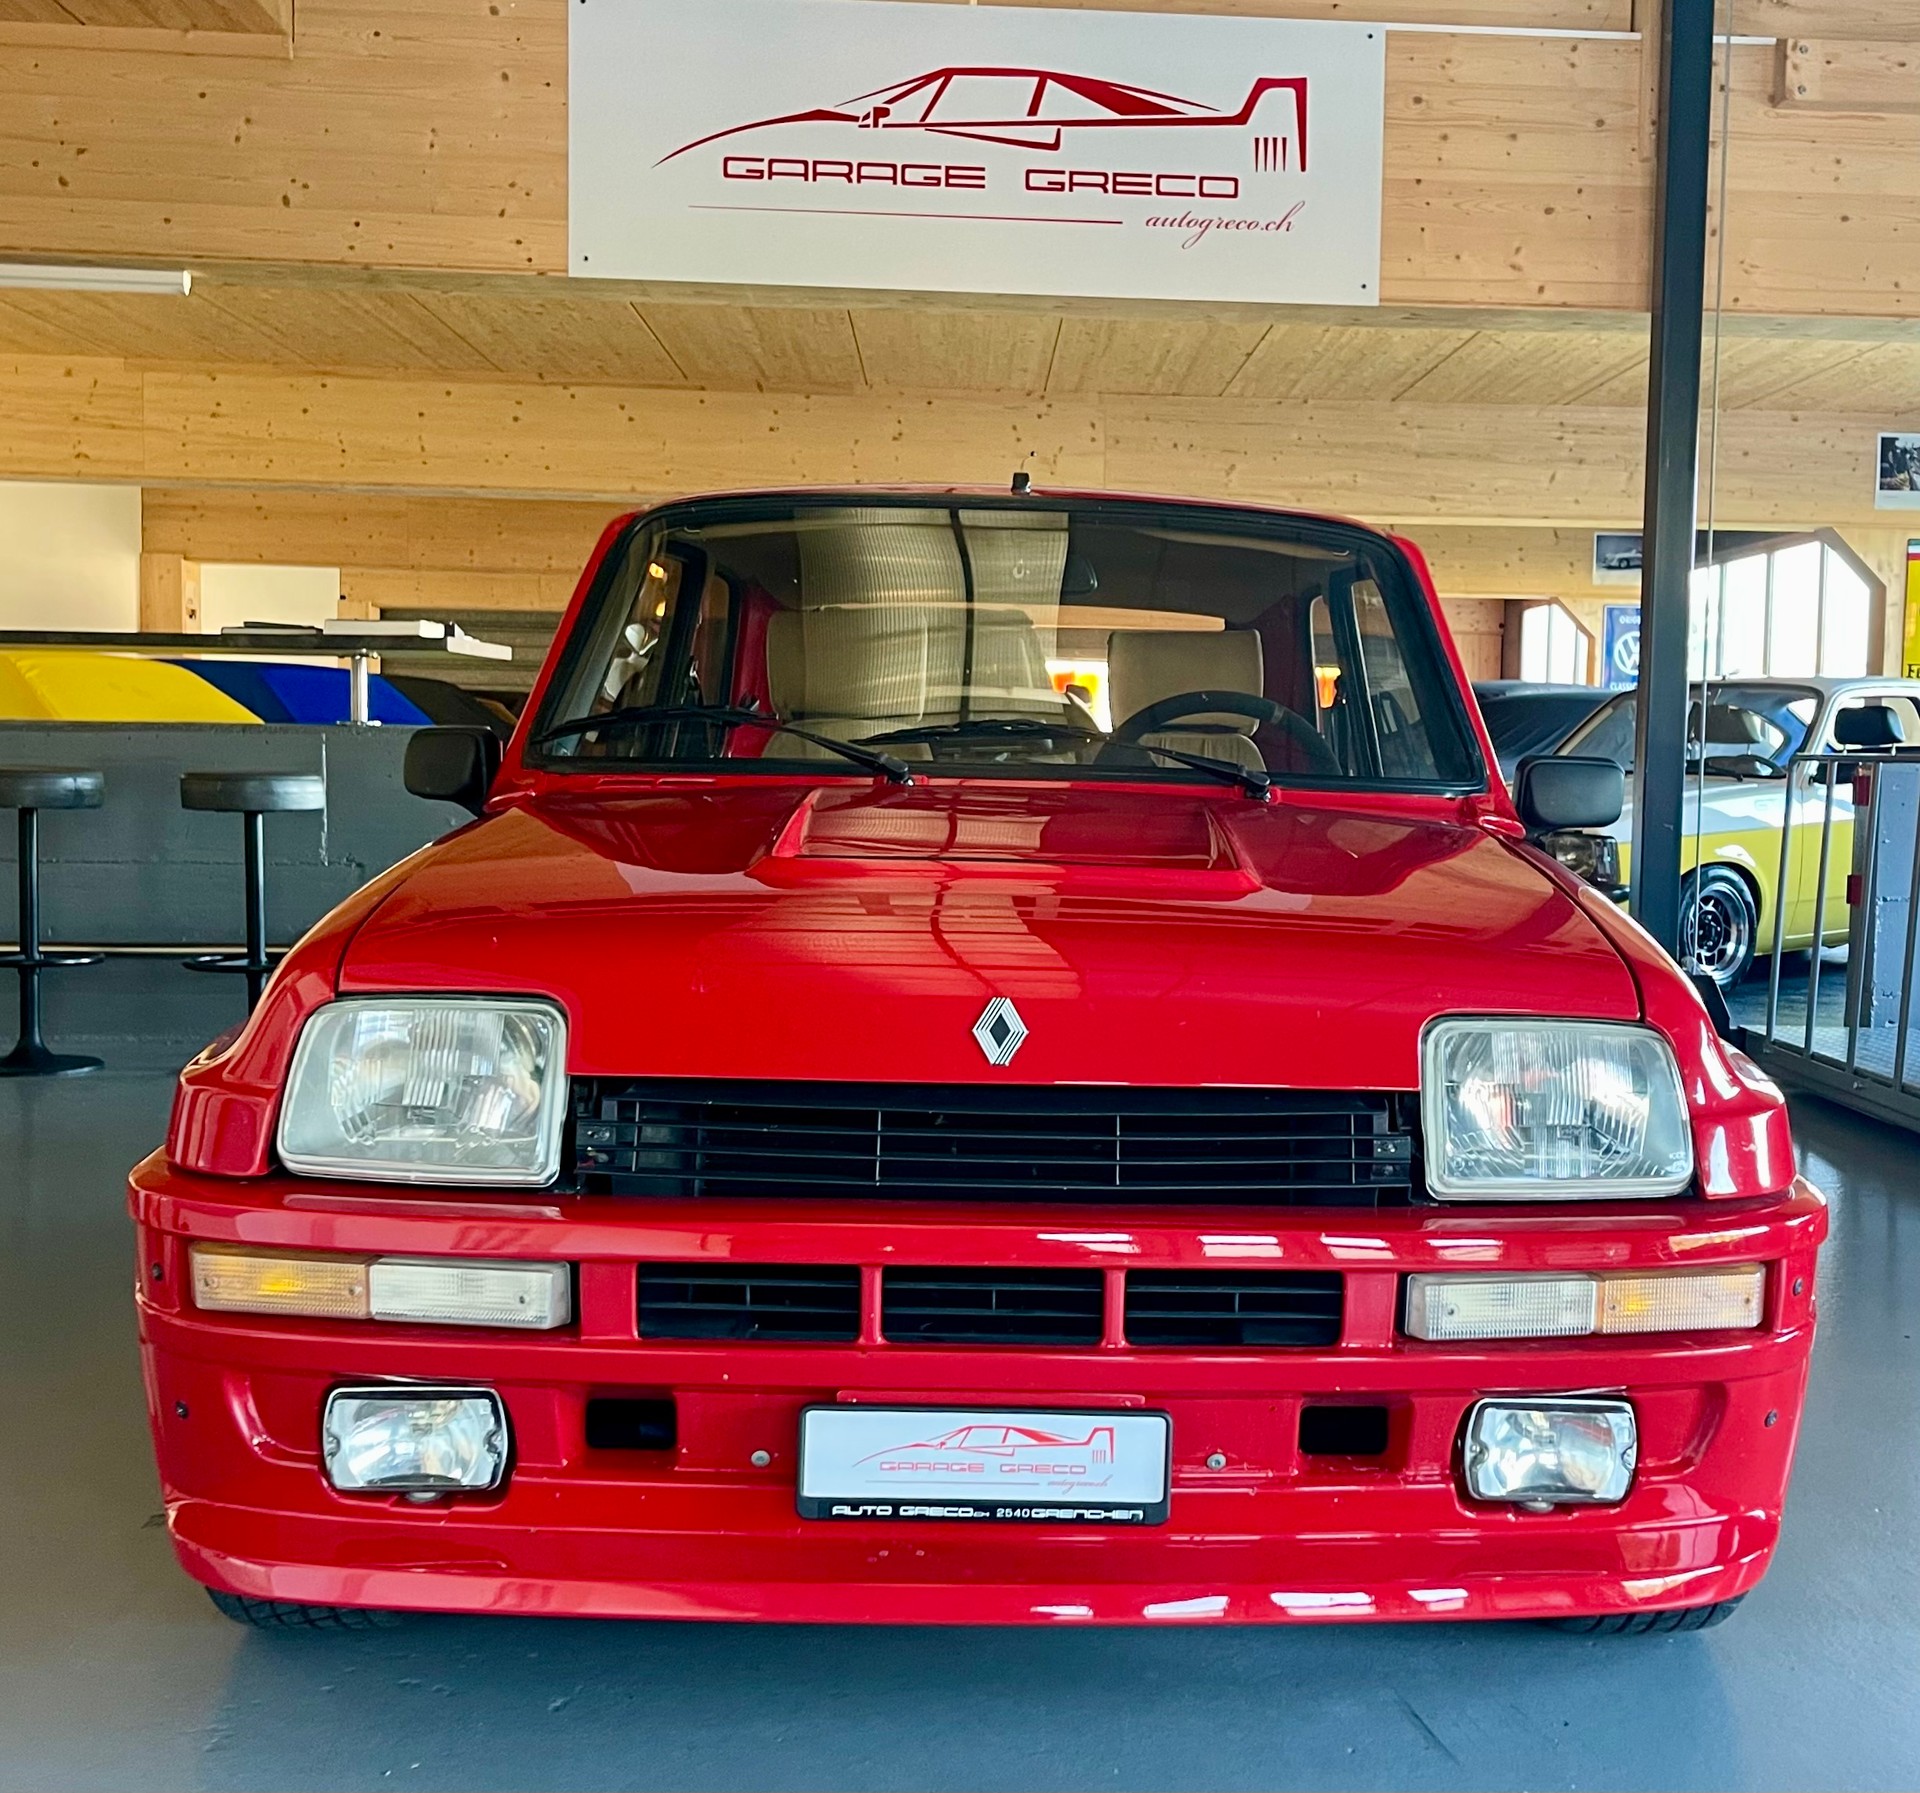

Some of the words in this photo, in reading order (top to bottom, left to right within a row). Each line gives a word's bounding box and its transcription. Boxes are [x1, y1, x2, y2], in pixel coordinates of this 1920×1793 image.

[722, 155, 986, 189] GARAGE
[1025, 168, 1239, 199] GRECO
[1145, 200, 1306, 250] autogreco.ch
[879, 1461, 985, 1473] GARAGE
[1000, 1463, 1087, 1475] GRECO
[831, 1505, 893, 1516] AUTO
[996, 1507, 1031, 1519] 2540
